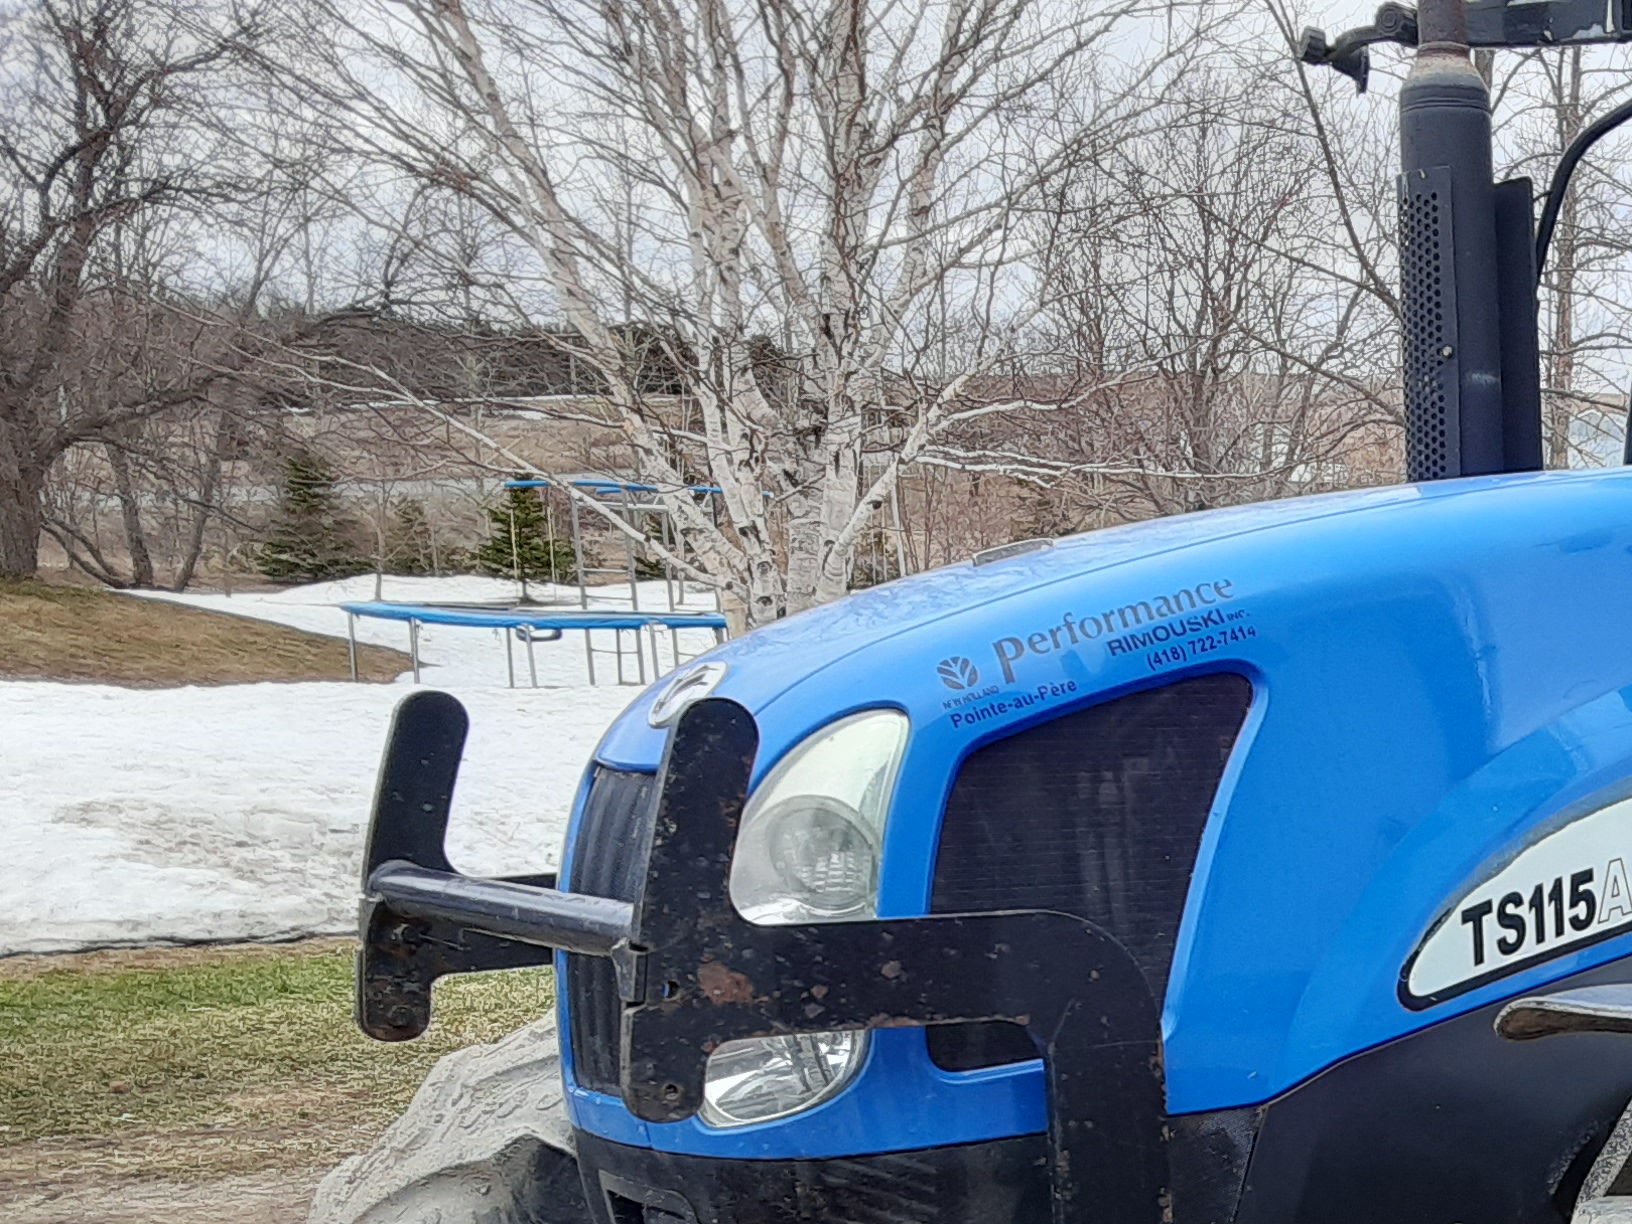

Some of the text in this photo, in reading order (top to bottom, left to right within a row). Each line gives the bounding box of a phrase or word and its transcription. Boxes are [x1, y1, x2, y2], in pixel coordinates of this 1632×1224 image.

[1106, 608, 1251, 657] RIMOUSKI INC.
[1147, 625, 1257, 671] (418) 722-7414
[950, 679, 1078, 729] Pointe-au-Père
